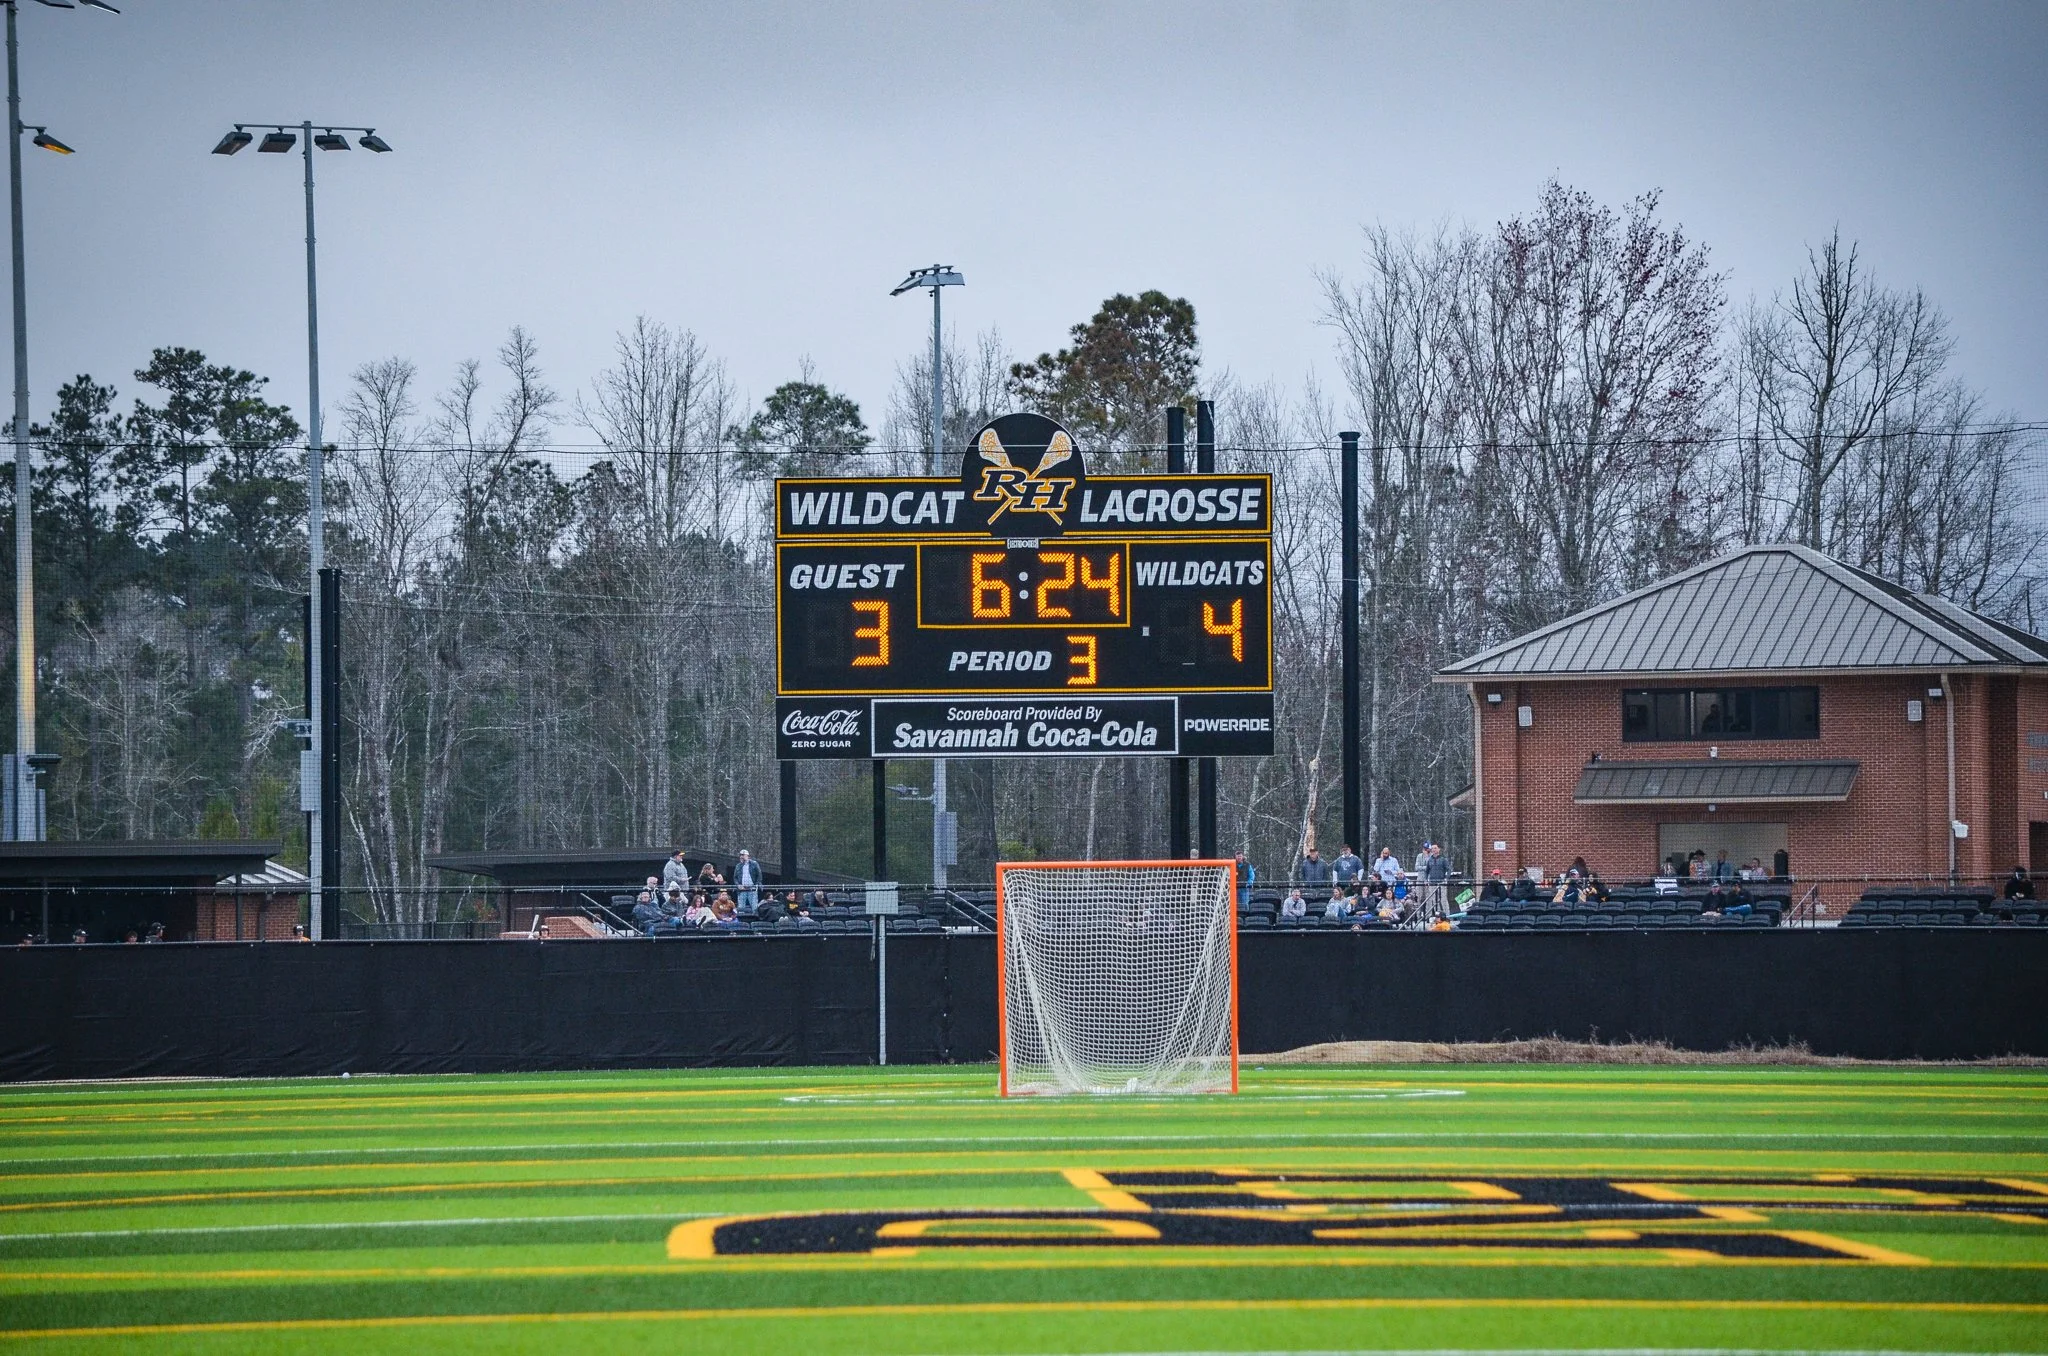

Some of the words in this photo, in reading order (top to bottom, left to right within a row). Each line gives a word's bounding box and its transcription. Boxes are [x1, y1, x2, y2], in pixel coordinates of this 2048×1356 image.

[974, 466, 1076, 512] RH
[791, 491, 965, 525] WILDCAT
[1080, 488, 1262, 523] LACROSSE
[789, 564, 905, 589] GUEST
[972, 553, 1119, 618] 6:24
[1136, 560, 1265, 586] WILDCATS
[851, 601, 889, 666] 3
[1203, 598, 1243, 662] 4
[948, 650, 1052, 672] PERIOD
[1066, 635, 1096, 685] 3
[781, 709, 863, 736] Coca-Cola
[947, 707, 1022, 721] Scoreboard
[1024, 706, 1082, 720] Provided
[1084, 705, 1102, 721] By
[1184, 719, 1271, 732] POWERADE
[819, 740, 851, 748] SUGAR
[893, 722, 1018, 748] Savannah
[1027, 721, 1158, 747] Coca-Cola
